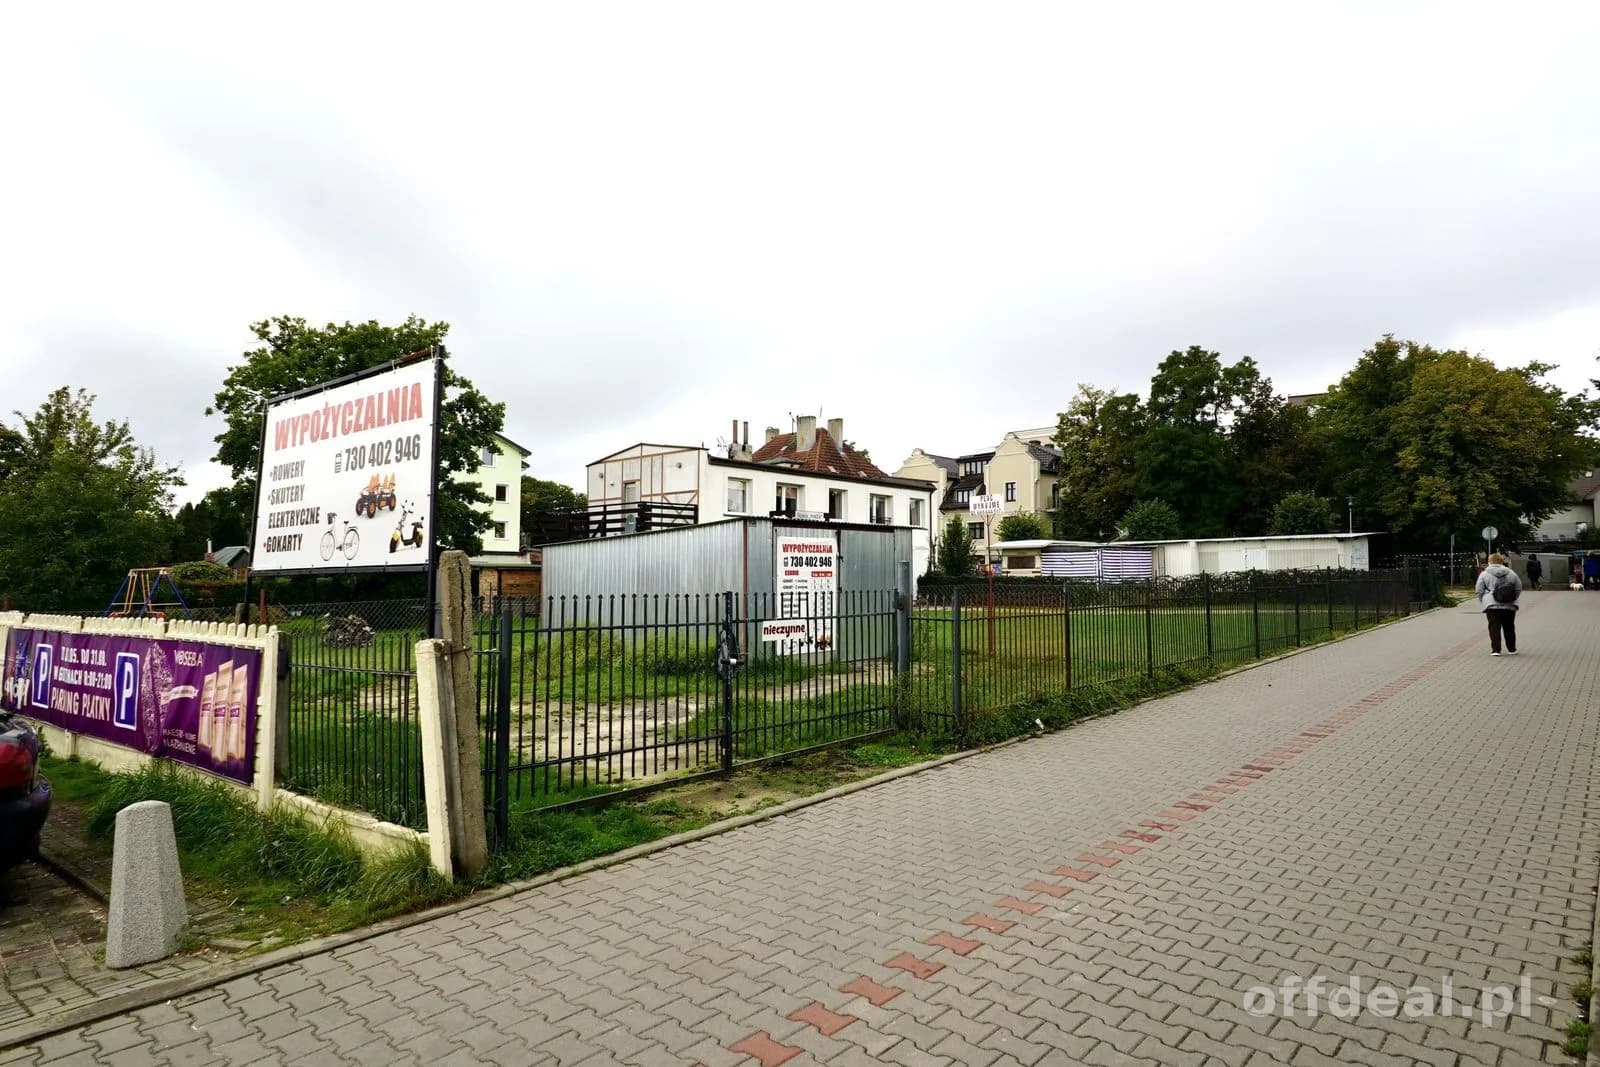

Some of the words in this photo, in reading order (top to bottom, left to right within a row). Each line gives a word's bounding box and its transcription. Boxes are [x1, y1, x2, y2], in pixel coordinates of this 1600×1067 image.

[275, 382, 423, 451] WYPOŻYCZALNIA
[345, 447, 365, 472] 730
[368, 439, 391, 467] 402
[395, 433, 421, 463] 946
[272, 459, 305, 482] ROWERY
[270, 484, 305, 505] SKUTERY
[268, 506, 320, 529] ELEKTRYCZNE
[266, 534, 303, 553] GOKARTY
[782, 543, 833, 553] WYPOŻYCZALNIA
[790, 556, 803, 567] 730
[805, 556, 818, 568] 402
[819, 556, 832, 568] 946
[763, 624, 806, 638] nieczynne
